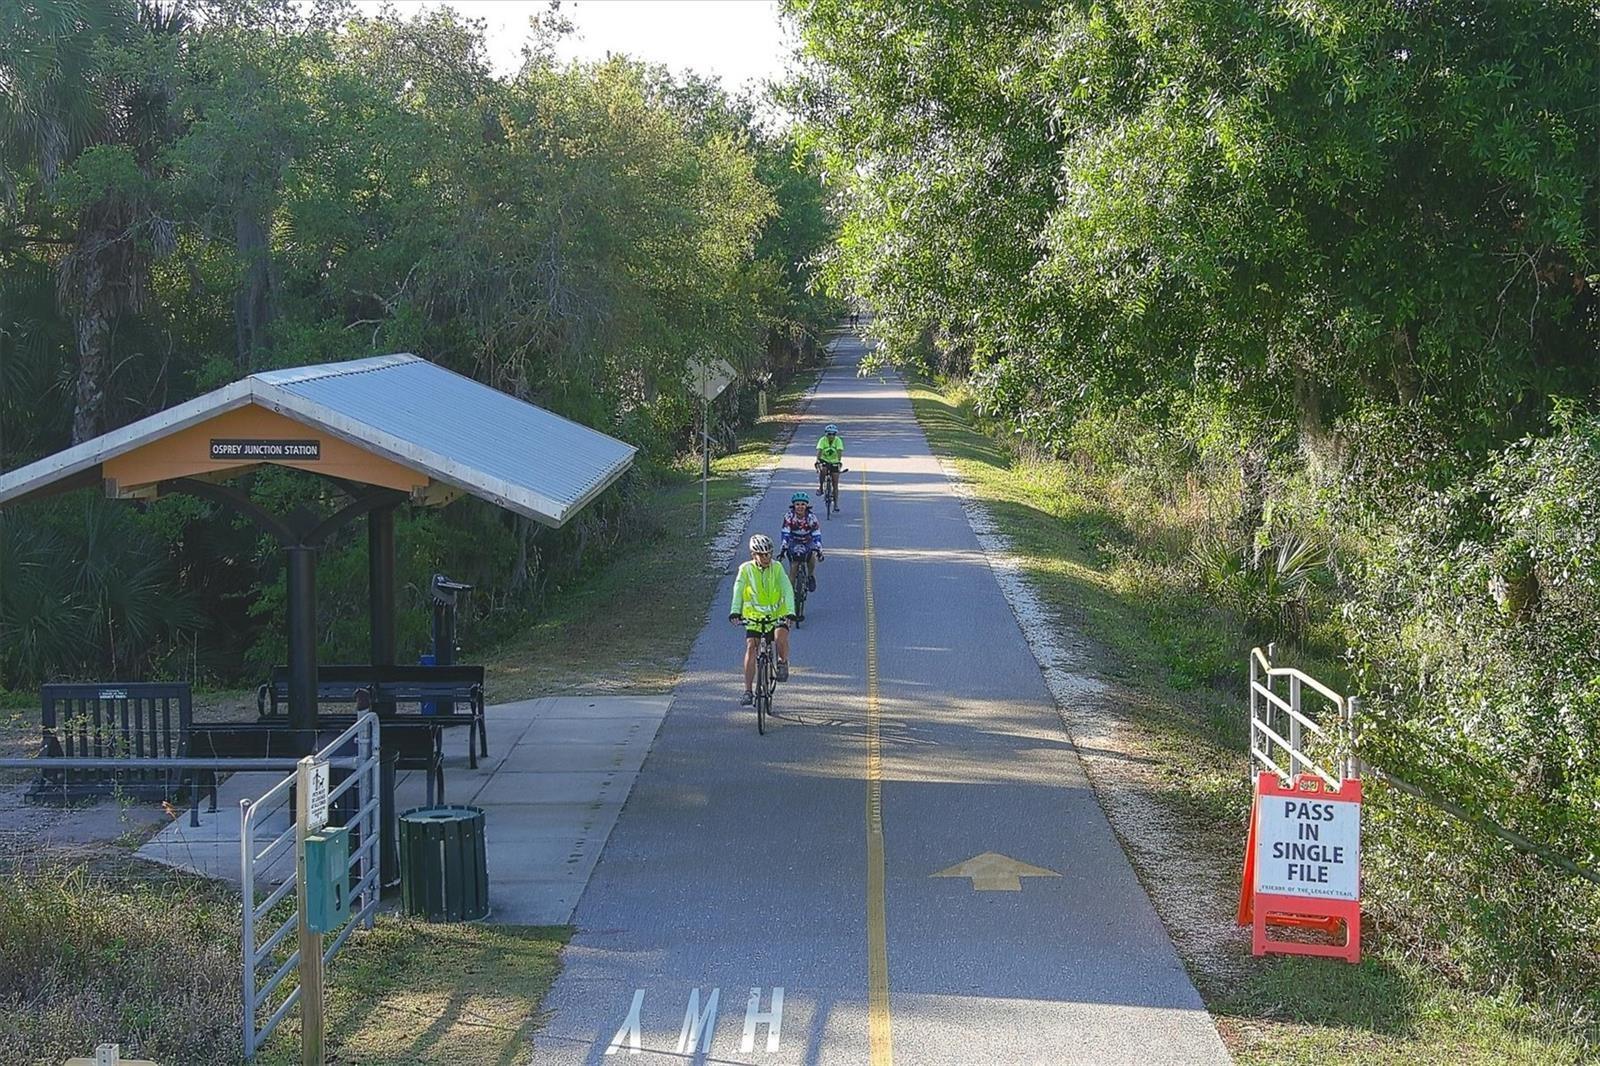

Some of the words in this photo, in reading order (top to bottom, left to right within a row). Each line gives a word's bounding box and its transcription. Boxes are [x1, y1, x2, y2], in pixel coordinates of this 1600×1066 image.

[212, 444, 242, 454] OSPREY
[244, 445, 282, 455] JUNCTION
[284, 445, 318, 455] STATION
[1284, 801, 1335, 821] PASS
[1298, 823, 1319, 841] IN
[1272, 842, 1344, 864] SINGLE
[1288, 863, 1329, 883] FILE
